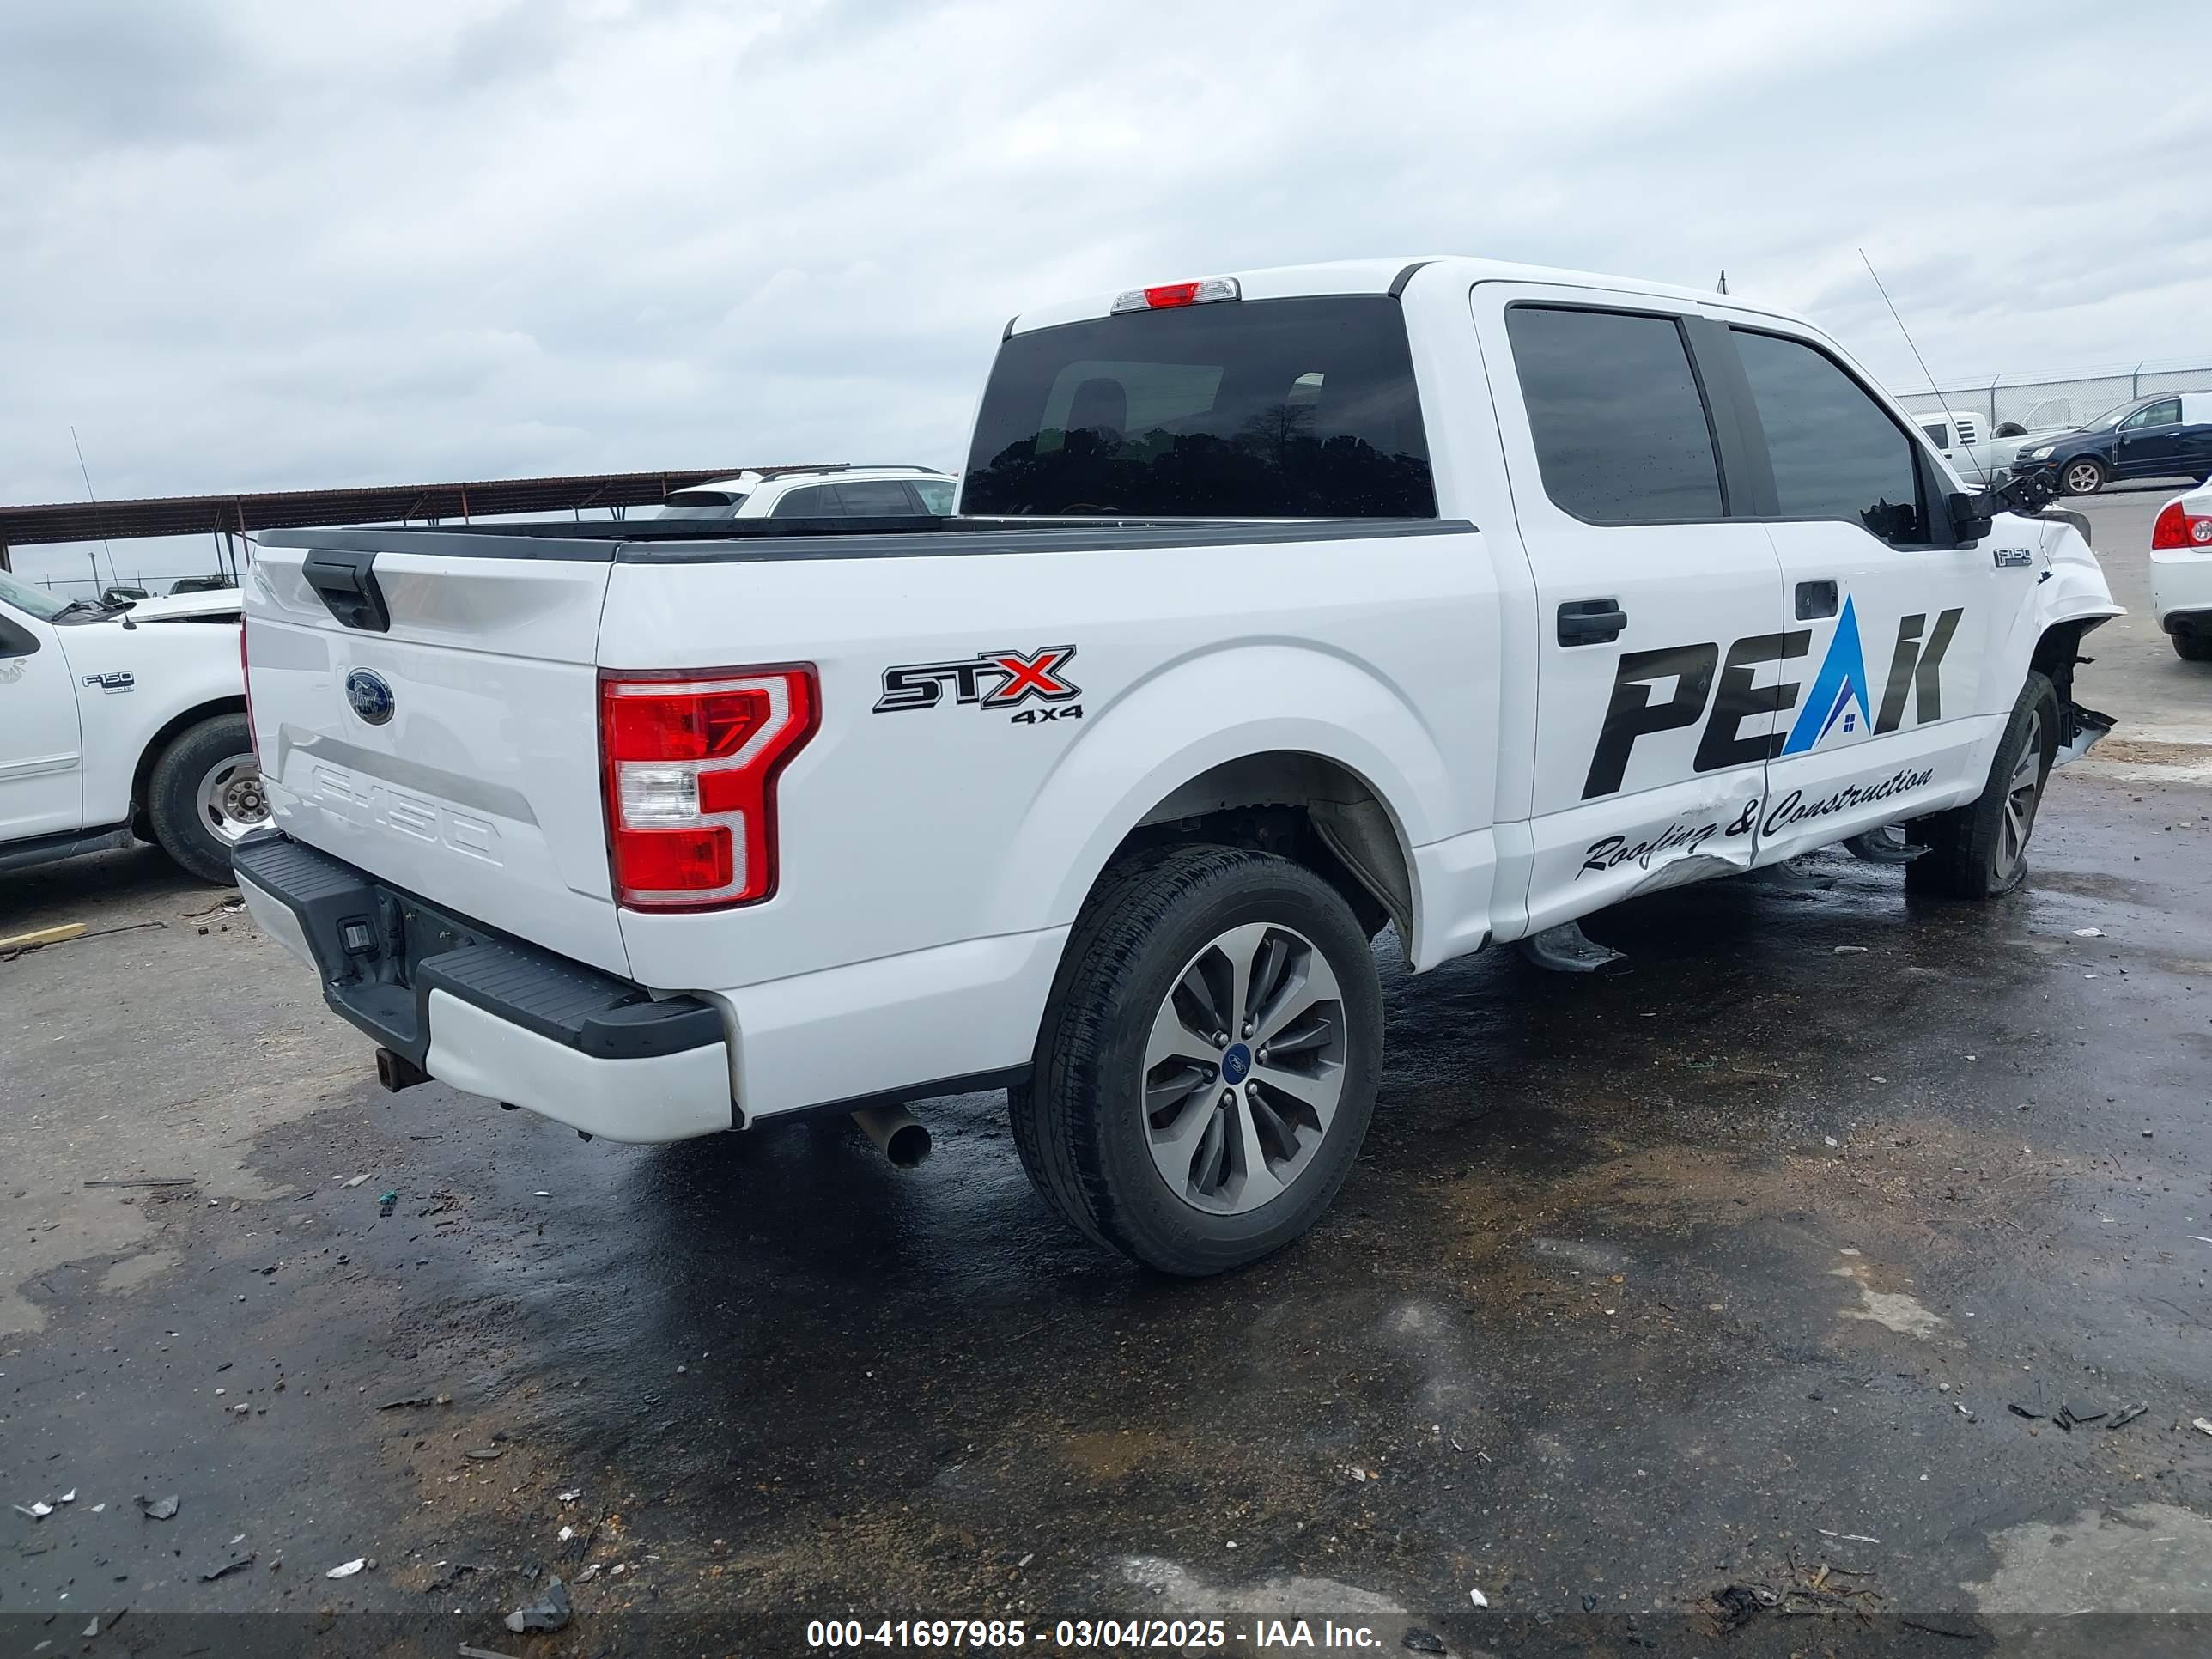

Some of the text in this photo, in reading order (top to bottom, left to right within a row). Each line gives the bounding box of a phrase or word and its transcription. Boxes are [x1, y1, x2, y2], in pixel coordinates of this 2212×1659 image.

[872, 644, 1083, 714] STX
[1581, 592, 1965, 801] PEAK
[313, 764, 505, 867] F-150
[1575, 766, 1934, 881] Roofing & Construction
